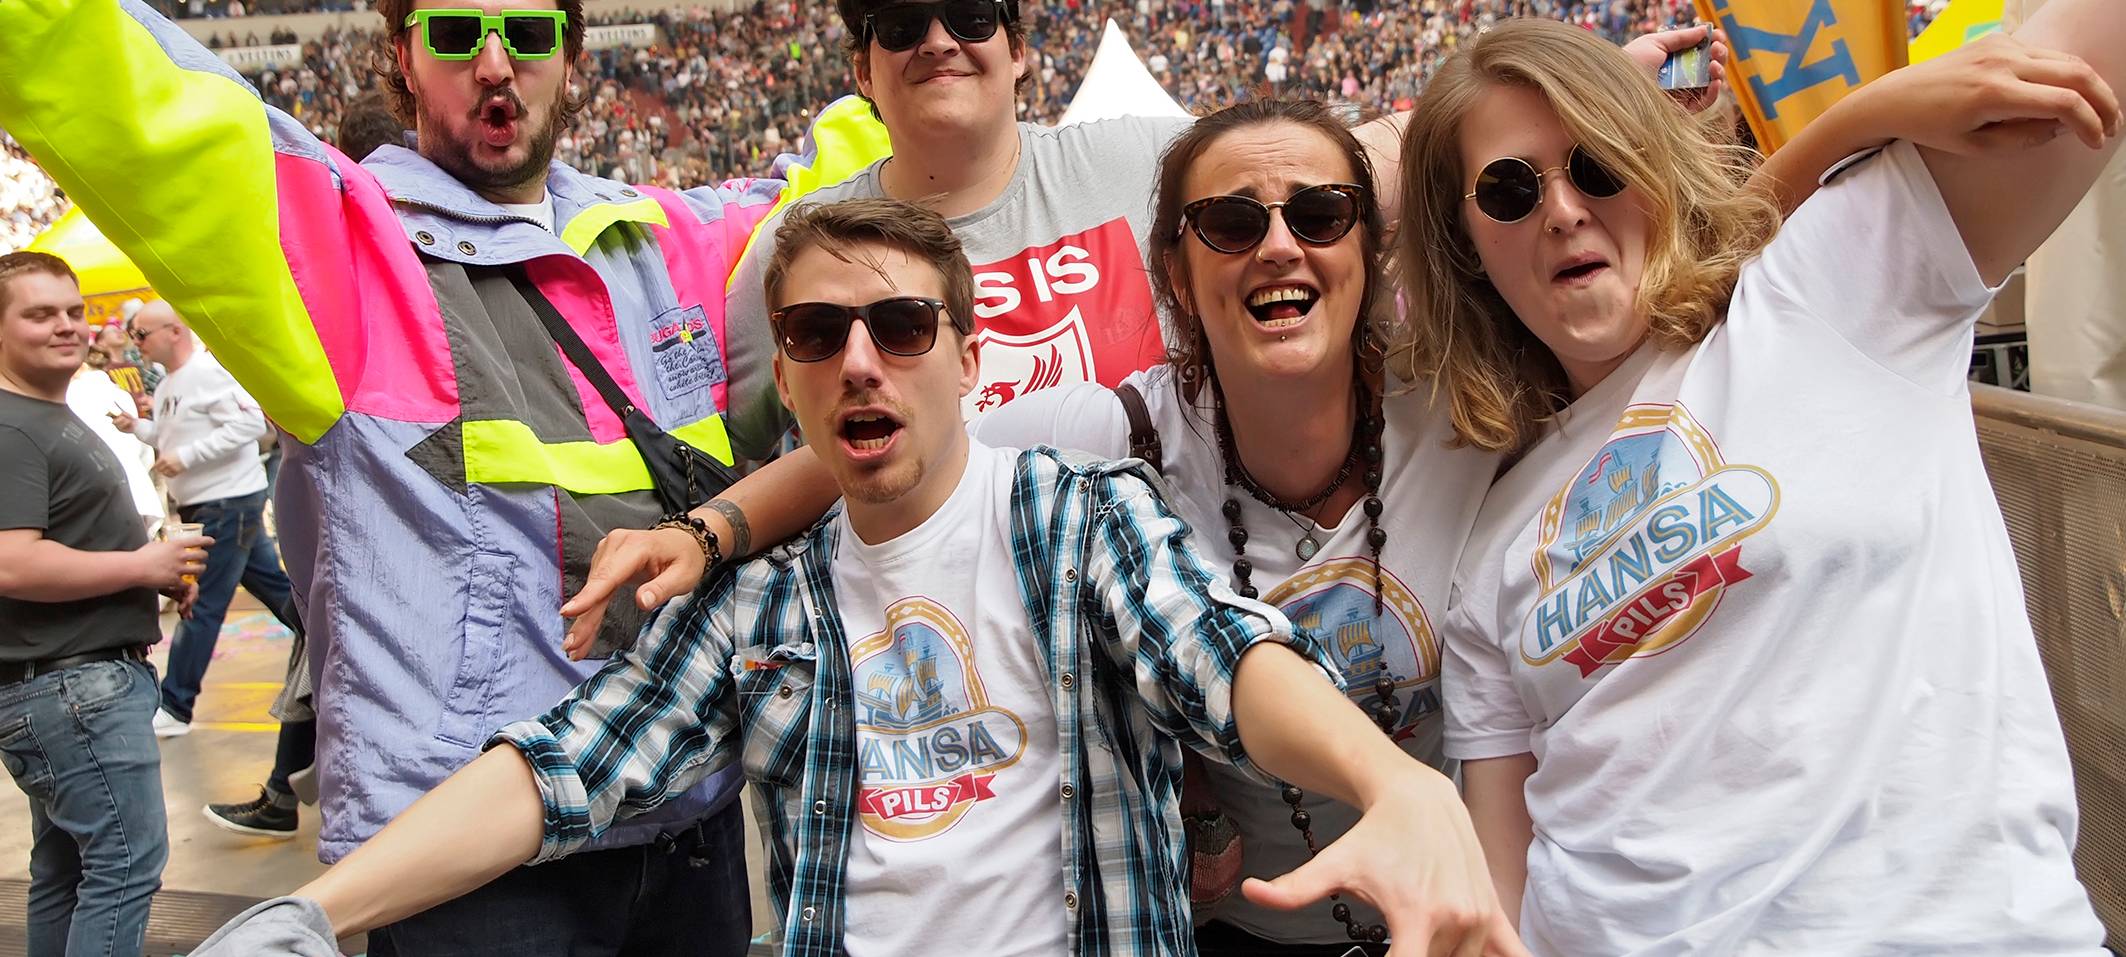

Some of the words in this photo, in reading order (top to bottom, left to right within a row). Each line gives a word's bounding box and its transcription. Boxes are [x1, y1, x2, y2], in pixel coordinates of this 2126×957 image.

[1027, 245, 1100, 303] IS
[1535, 483, 1755, 652] HANSA
[1611, 581, 1691, 640] PILS
[860, 720, 1008, 782] ANSA
[880, 786, 951, 817] PILS
